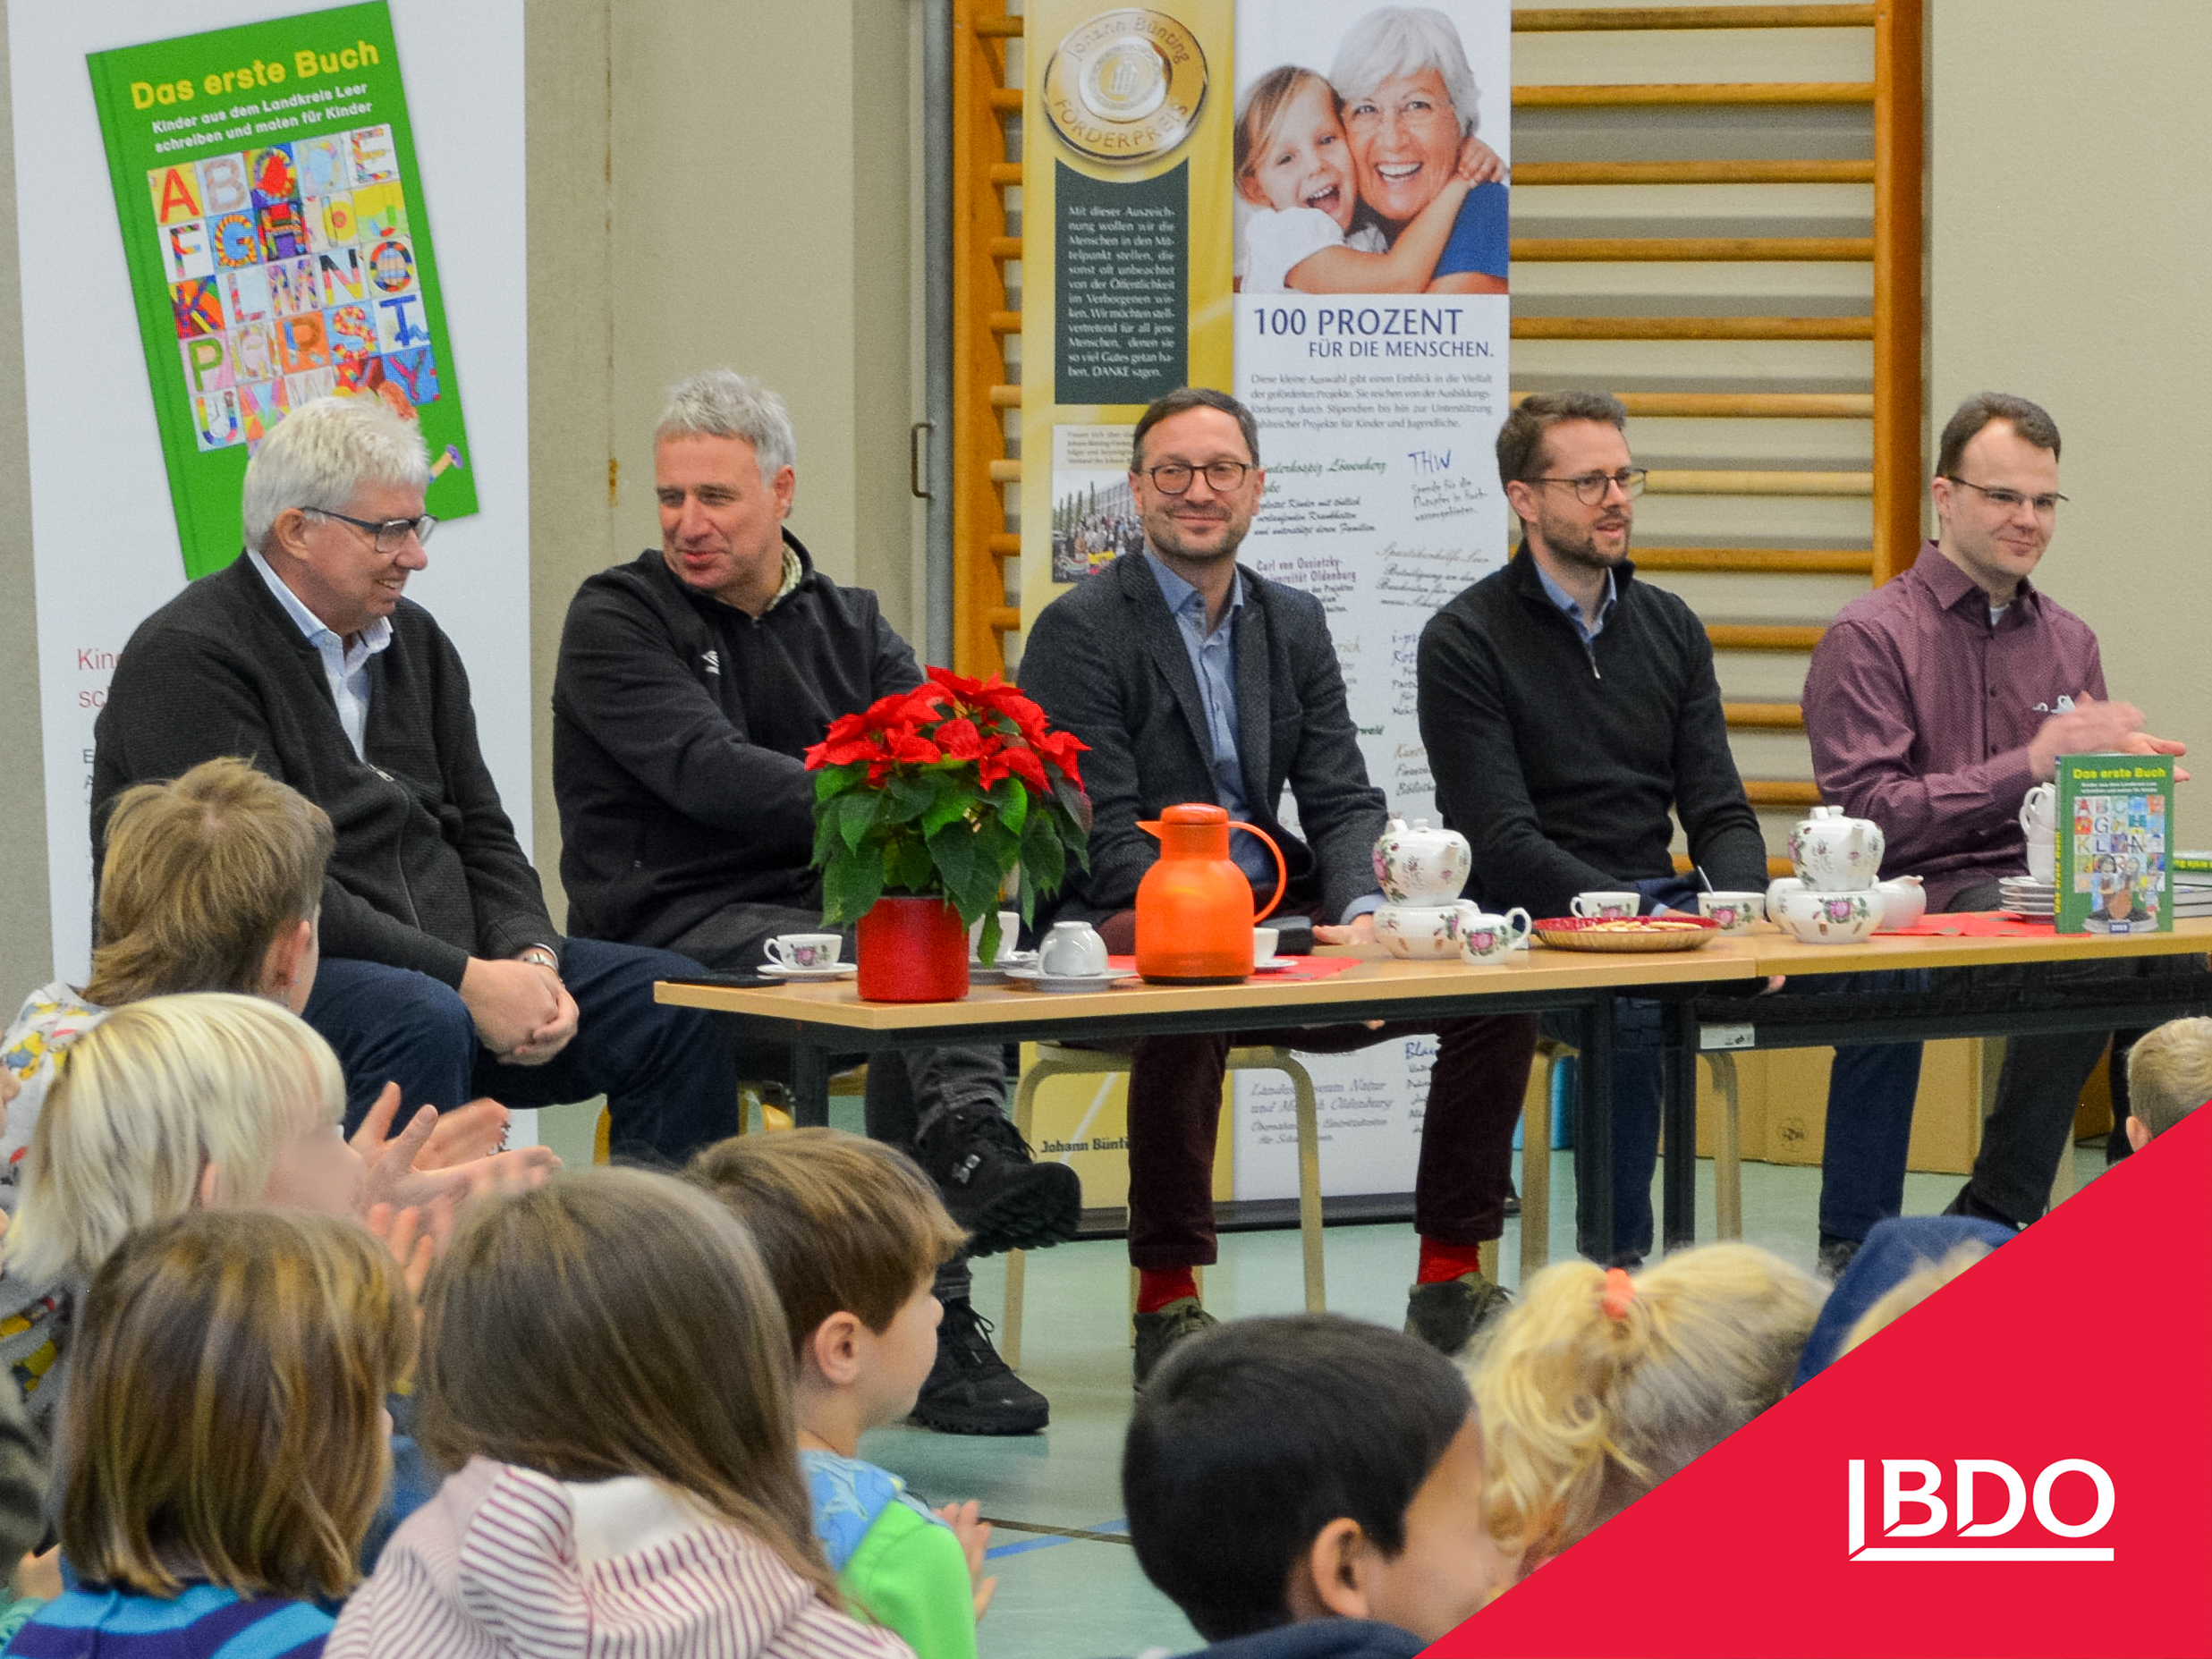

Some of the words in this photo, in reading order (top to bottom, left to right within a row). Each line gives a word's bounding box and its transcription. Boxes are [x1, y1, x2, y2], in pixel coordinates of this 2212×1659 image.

[131, 79, 194, 111] Das
[202, 59, 285, 96] erste
[294, 40, 379, 76] Buch
[152, 113, 198, 134] Kinder
[199, 110, 226, 126] aus
[230, 101, 260, 120] dem
[261, 87, 332, 114] Landkreis
[335, 82, 368, 99] Leer
[154, 129, 224, 155] schreiben
[225, 123, 251, 140] und
[254, 114, 299, 136] malen
[301, 108, 324, 128] für
[326, 99, 372, 121] Kinder
[159, 168, 199, 224] A
[352, 127, 394, 183] E
[215, 214, 258, 268] G
[318, 248, 363, 301] N
[1254, 308, 1307, 336] 100
[1318, 308, 1464, 336] PROZENT
[1309, 339, 1343, 359] FÜR
[1349, 342, 1379, 359] DIE
[1386, 341, 1495, 359] MENSCHEN.
[1408, 449, 1453, 474] THW
[2072, 768, 2098, 780] Das
[2100, 767, 2132, 779] erste
[2134, 767, 2166, 779] Buch
[1040, 1139, 1089, 1154] Johann
[1092, 1137, 1129, 1151] Bünti
